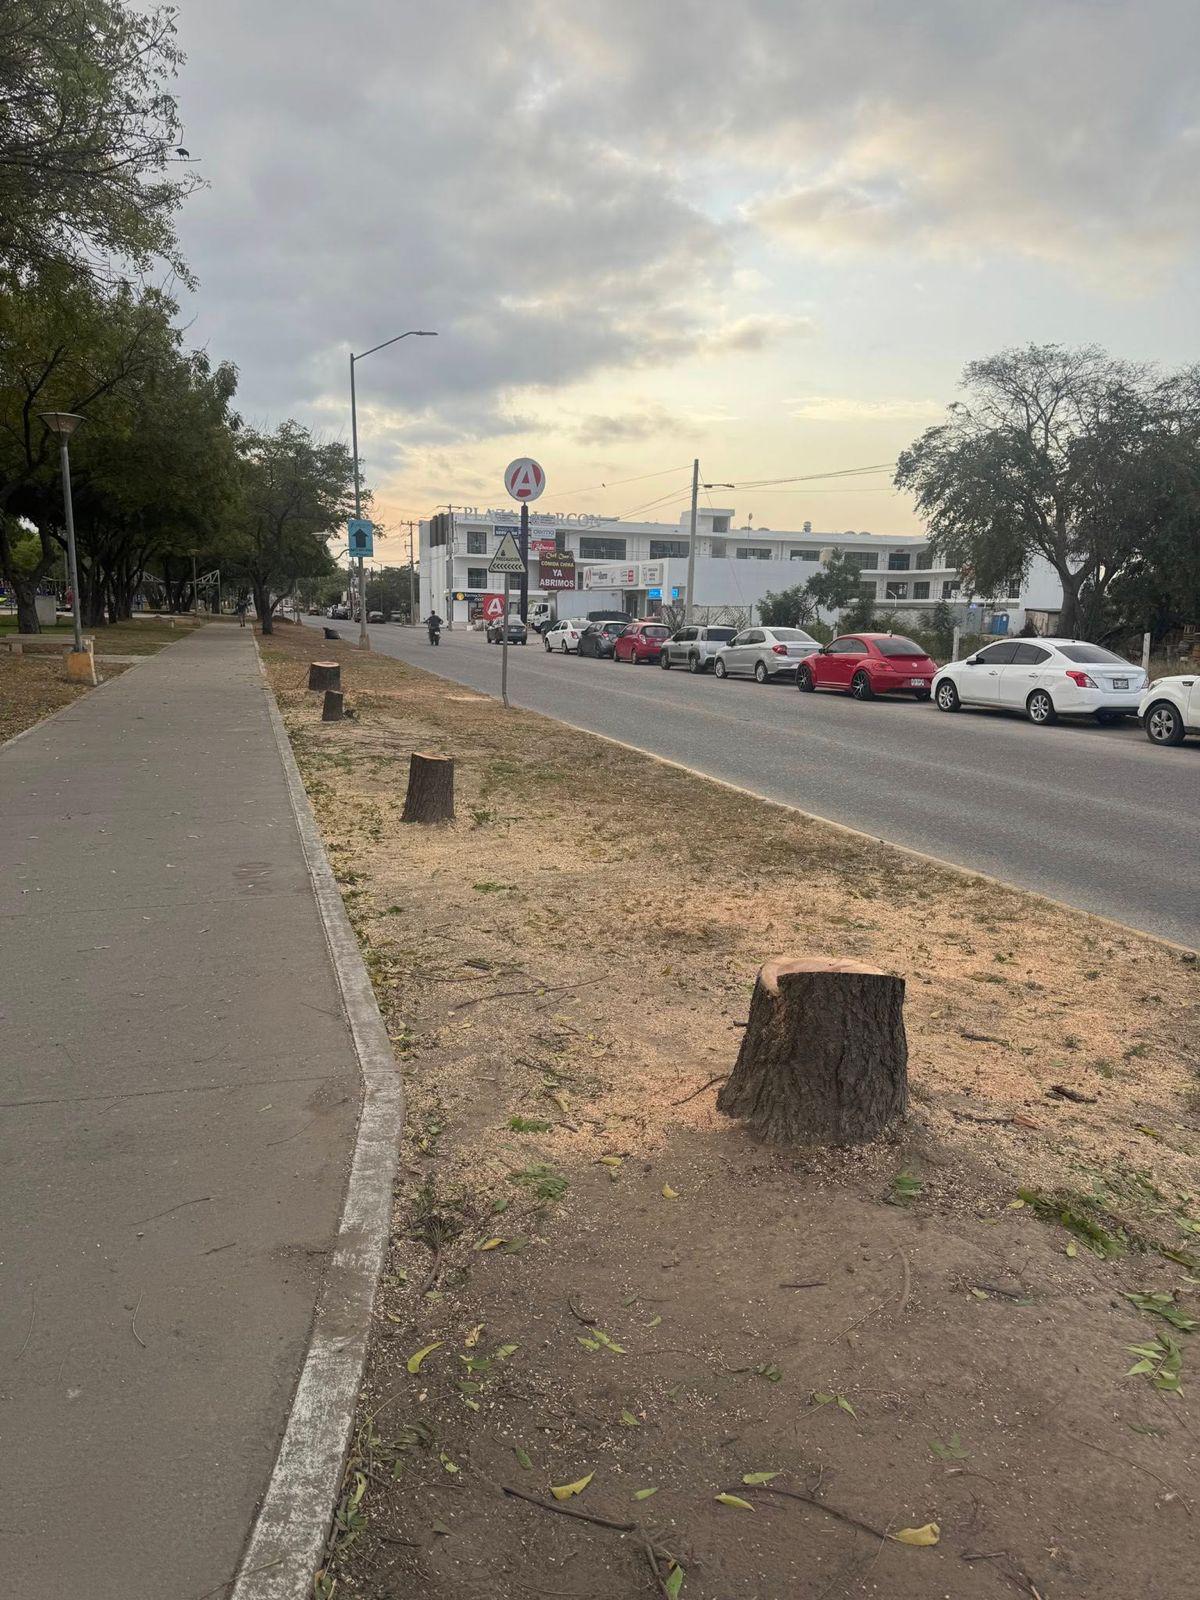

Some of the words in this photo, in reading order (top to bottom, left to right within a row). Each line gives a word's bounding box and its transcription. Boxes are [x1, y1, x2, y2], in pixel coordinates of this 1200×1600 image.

[463, 506, 514, 521] PLA
[552, 569, 563, 577] YA
[539, 578, 574, 587] ABRIMOS
[487, 597, 503, 616] A
